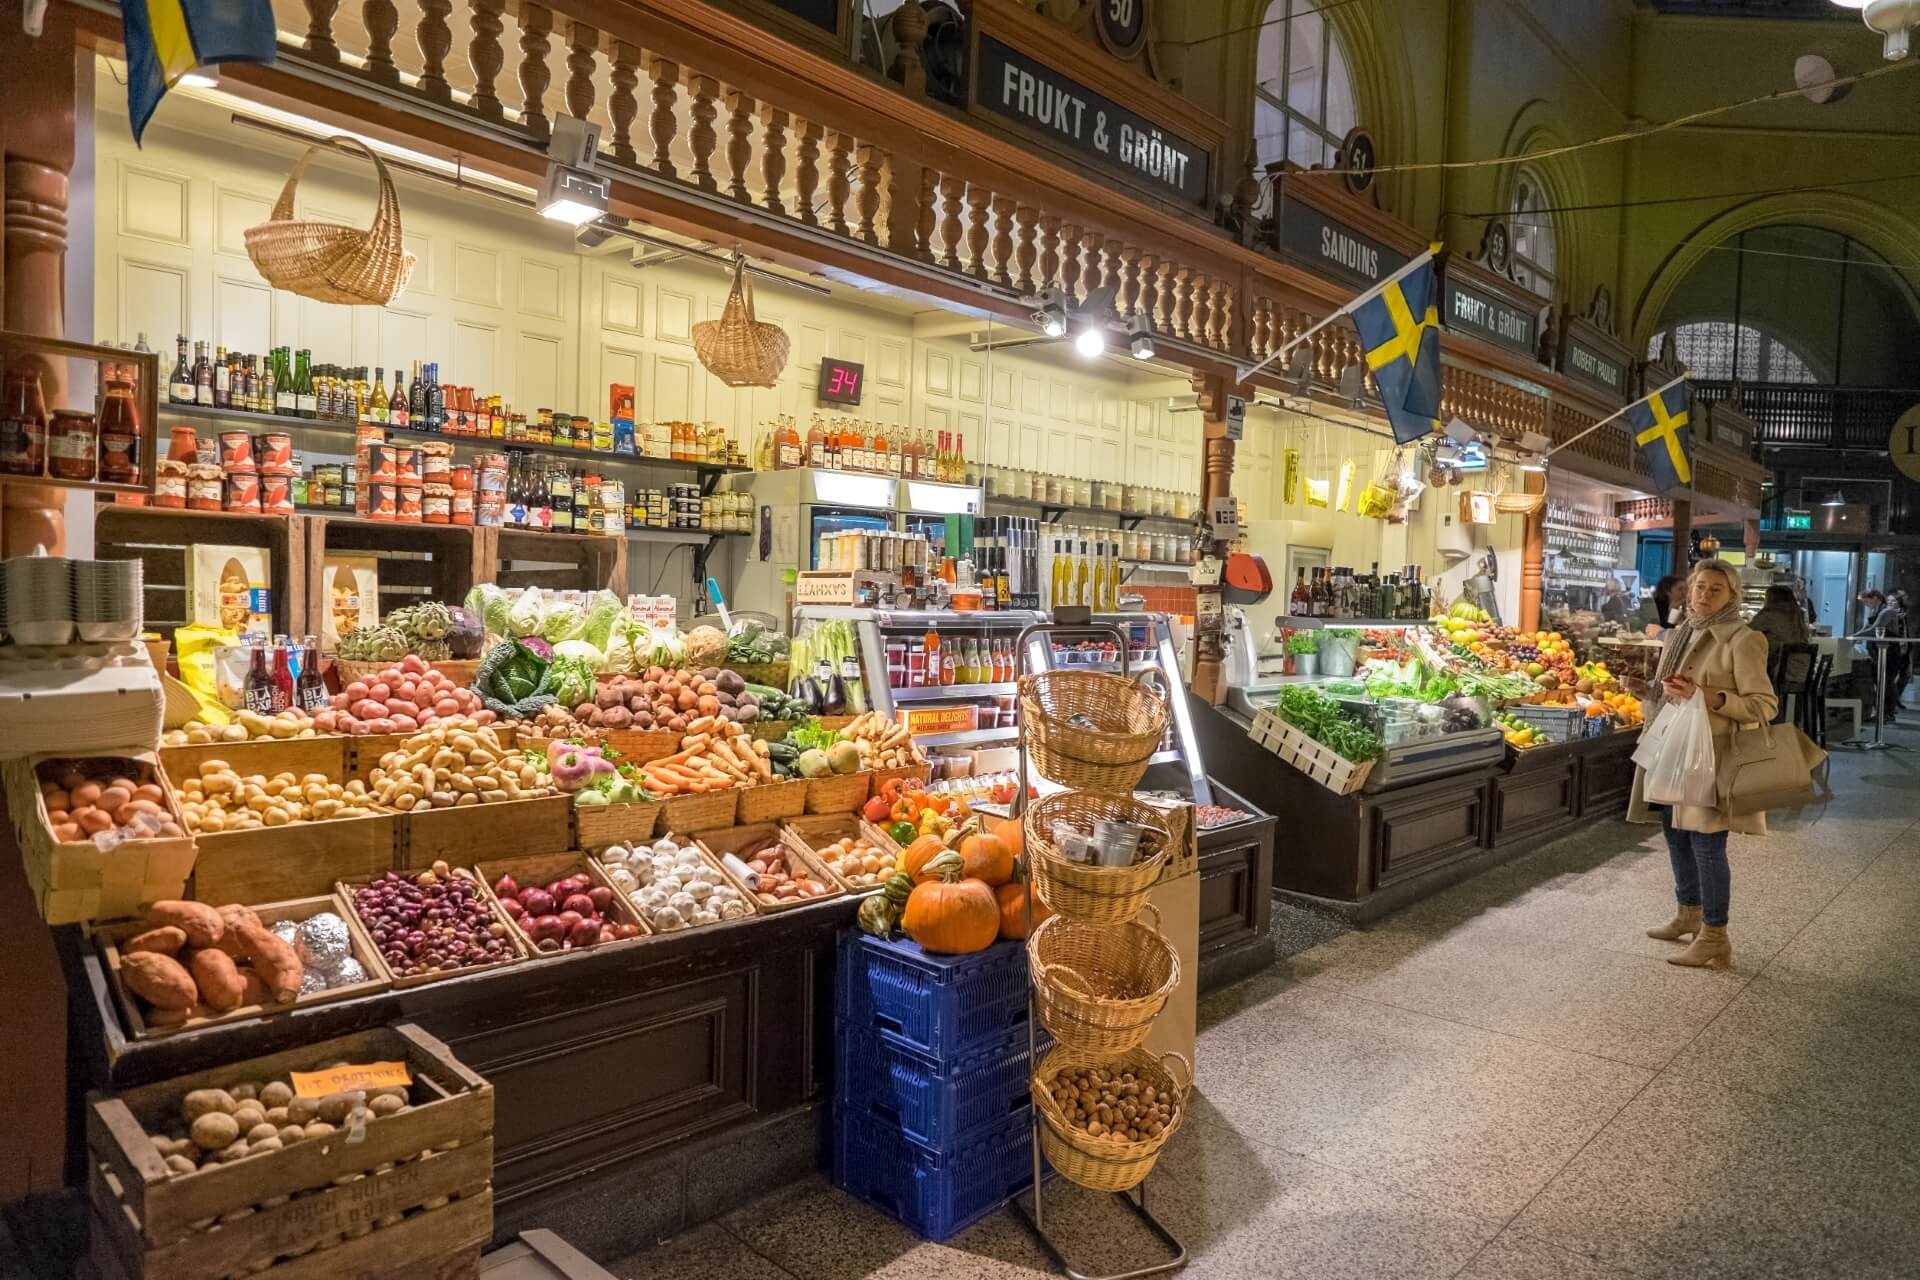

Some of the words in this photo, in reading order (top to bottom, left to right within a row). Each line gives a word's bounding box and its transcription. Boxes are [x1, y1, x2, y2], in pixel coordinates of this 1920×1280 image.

[1002, 61, 1086, 140] FRUKT
[1093, 111, 1109, 153] &
[1119, 123, 1189, 190] GRÖNT
[1321, 226, 1378, 279] SANDINS
[1455, 291, 1486, 326] FRUKT
[1488, 306, 1495, 331] &
[1499, 311, 1527, 343] GRÖNT
[1572, 346, 1597, 375] ROBERT
[827, 367, 858, 396] 34
[910, 711, 939, 725] NATURAL
[941, 709, 969, 723] DELIGHTS
